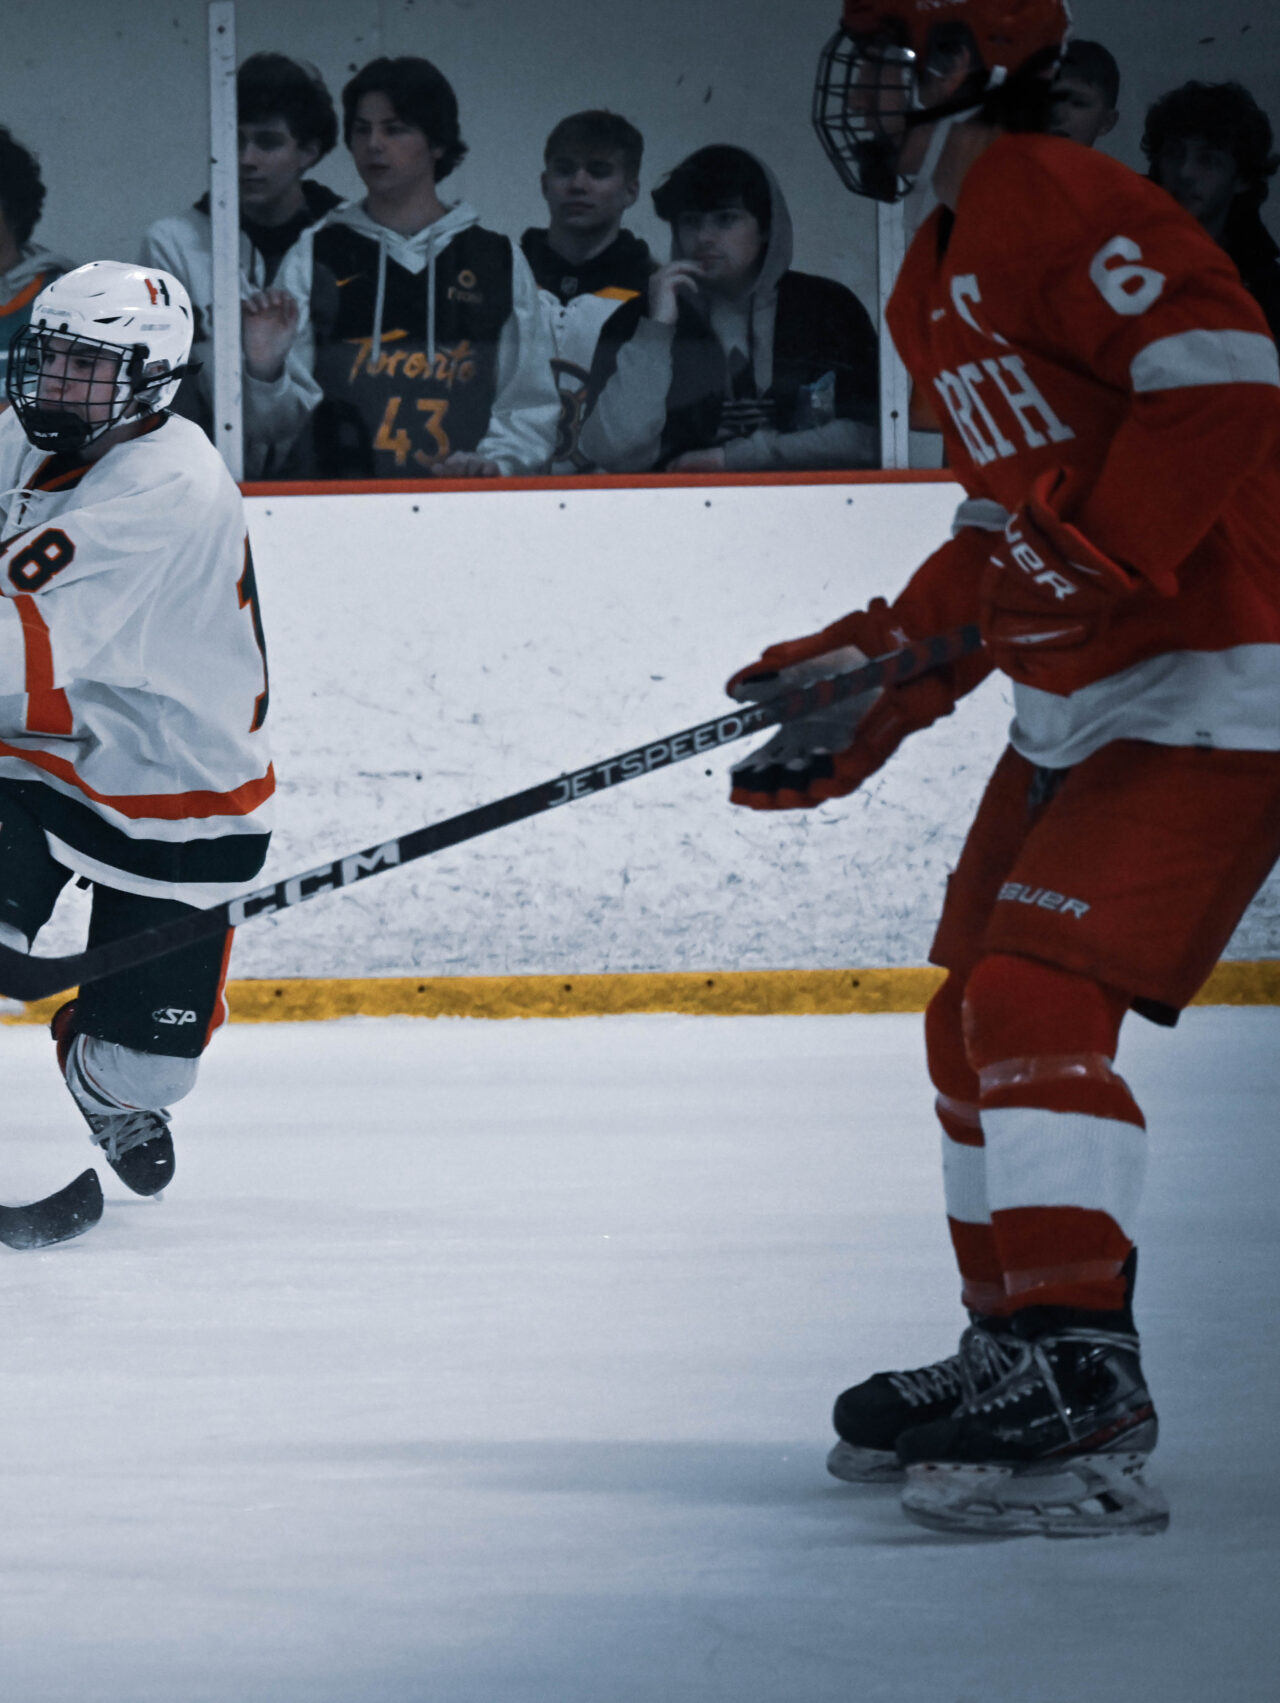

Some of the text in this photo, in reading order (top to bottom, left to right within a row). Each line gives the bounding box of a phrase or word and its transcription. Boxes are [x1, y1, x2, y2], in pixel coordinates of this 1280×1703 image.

[1089, 235, 1166, 315] 6
[373, 397, 450, 466] 43
[933, 354, 1077, 466] RTH
[228, 840, 400, 927] CCM
[548, 716, 744, 806] JETSPEED
